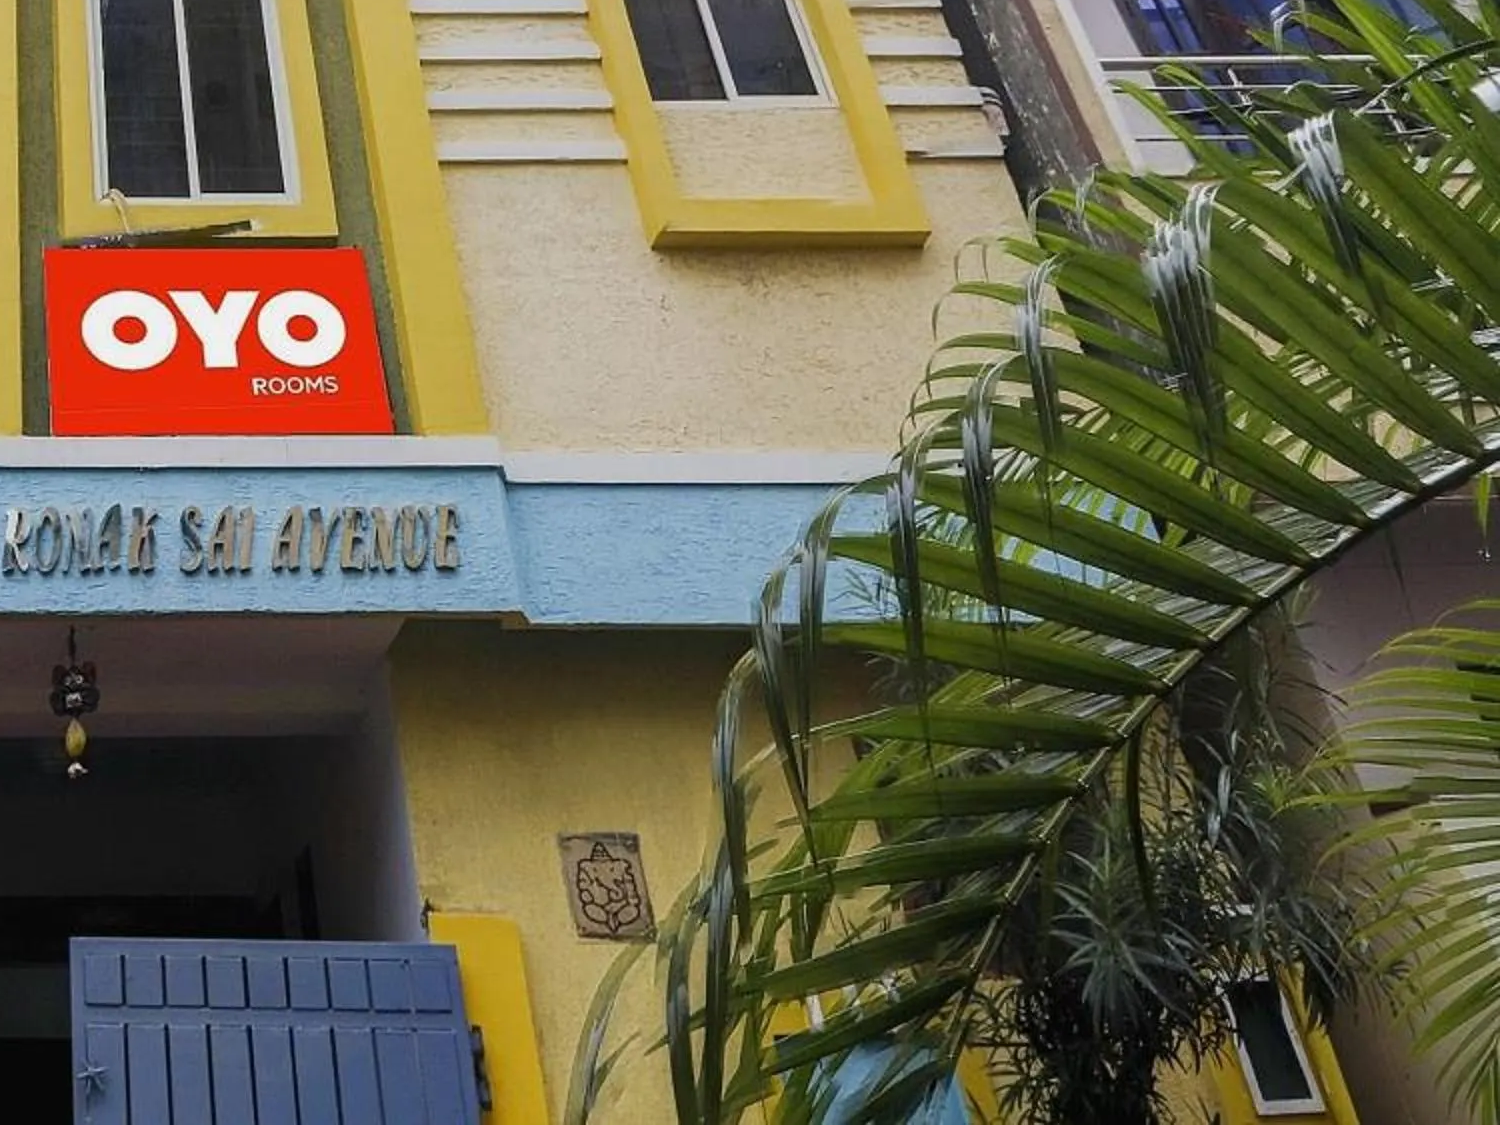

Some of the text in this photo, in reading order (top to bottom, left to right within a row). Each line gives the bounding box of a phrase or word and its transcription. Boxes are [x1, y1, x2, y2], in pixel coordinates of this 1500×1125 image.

[81, 290, 347, 371] OYO
[251, 376, 340, 396] ROOMS
[2, 504, 462, 575] RONAK SAI AVENUE
